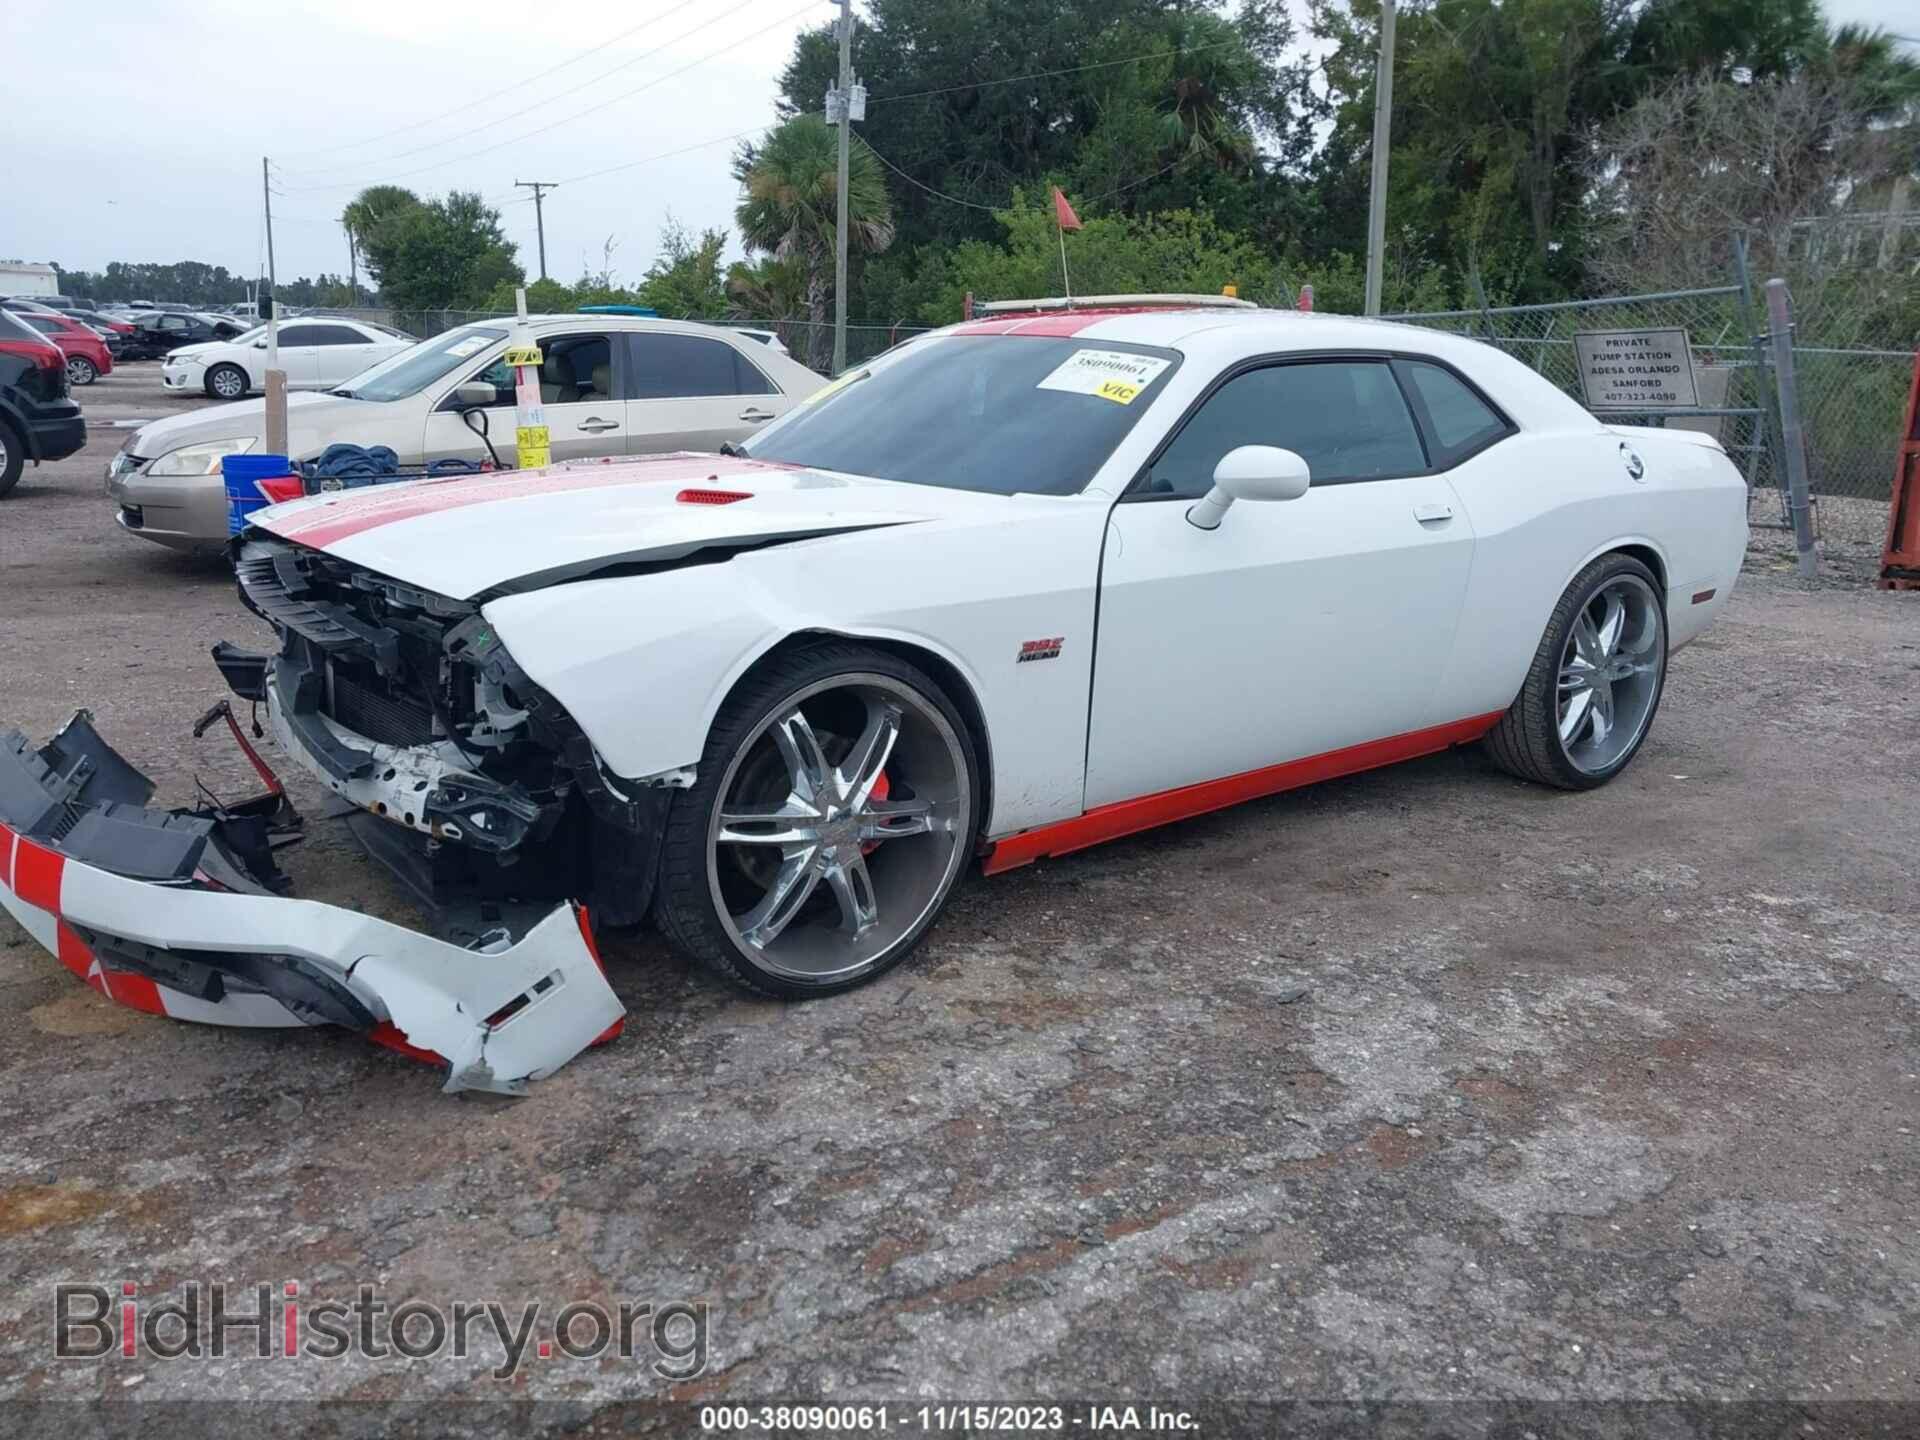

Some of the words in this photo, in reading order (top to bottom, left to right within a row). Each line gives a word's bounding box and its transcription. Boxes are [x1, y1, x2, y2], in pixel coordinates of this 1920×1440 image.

[1606, 338, 1651, 347] PRIVATE
[1592, 353, 1622, 361] PUMP
[1624, 351, 1672, 361] STATION
[1591, 366, 1625, 375] ADESA
[1627, 365, 1680, 374] ORLANDO
[1612, 379, 1662, 388] SANFORD
[1103, 382, 1134, 399] VIC
